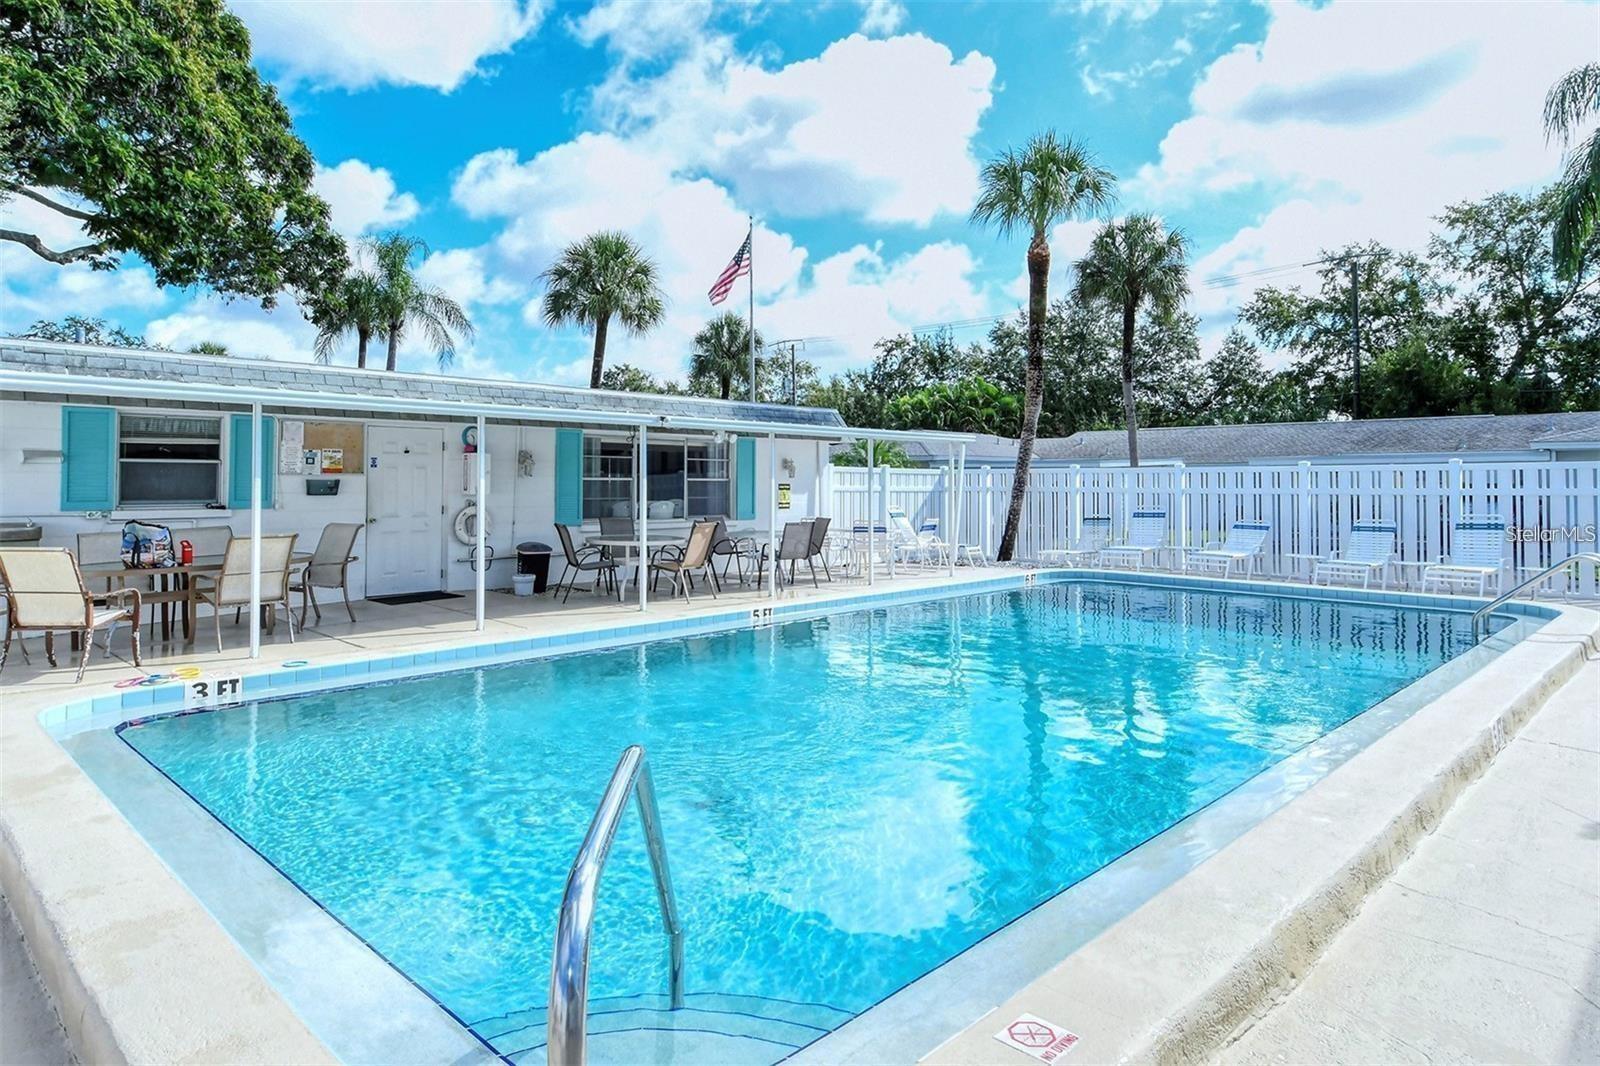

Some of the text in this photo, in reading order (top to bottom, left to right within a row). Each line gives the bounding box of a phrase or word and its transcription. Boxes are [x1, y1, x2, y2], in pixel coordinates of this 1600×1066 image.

[752, 607, 772, 618] 5 FT
[192, 678, 240, 699] 3 FT
[1040, 1050, 1057, 1063] NO
